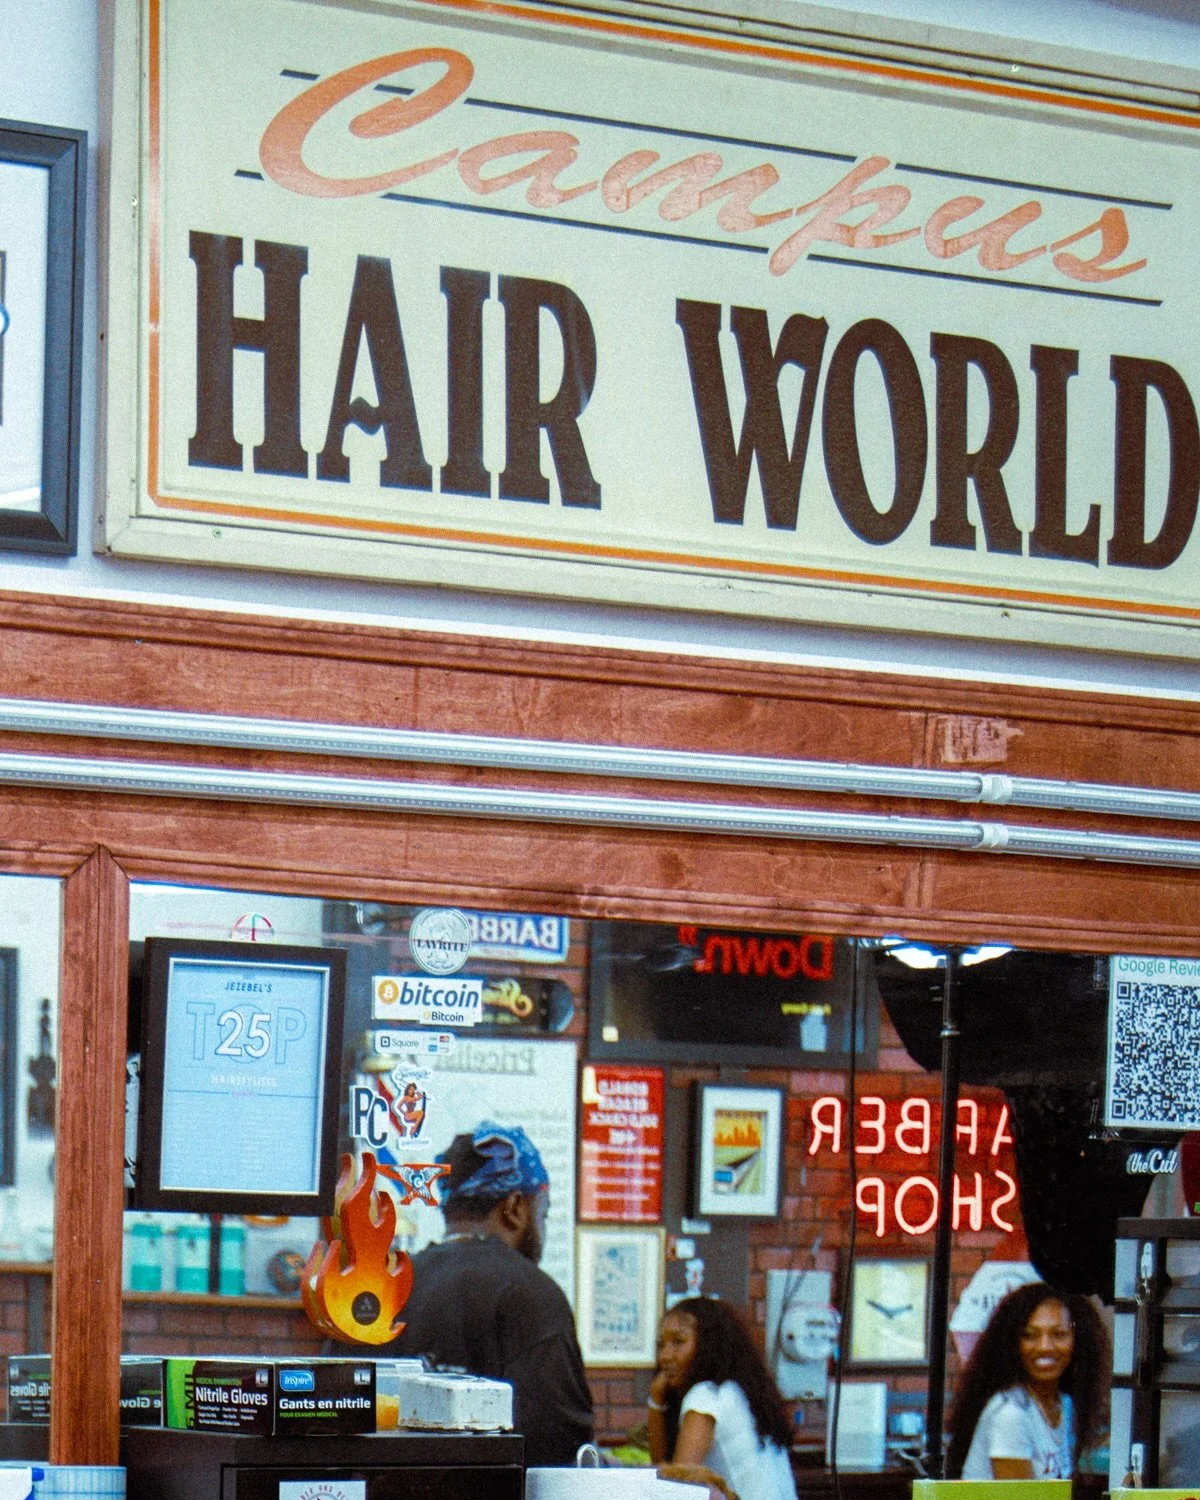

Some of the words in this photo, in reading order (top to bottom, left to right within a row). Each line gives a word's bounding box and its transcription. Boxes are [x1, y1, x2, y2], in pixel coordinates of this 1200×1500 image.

[260, 47, 1147, 277] Campus
[188, 229, 602, 511] HAIR
[675, 297, 1200, 571] WORLD
[1119, 956, 1166, 977] Google
[224, 981, 273, 993] JEZEBEL'S
[400, 981, 480, 1009] bitcoin
[431, 1010, 465, 1023] Bitcoin
[215, 1010, 272, 1060] 25
[391, 1036, 420, 1048] Square
[195, 1386, 229, 1403] Nitrile
[231, 1388, 268, 1405] Gloves
[279, 1399, 315, 1409] Gants
[318, 1401, 332, 1409] en
[335, 1398, 371, 1409] nitrile
